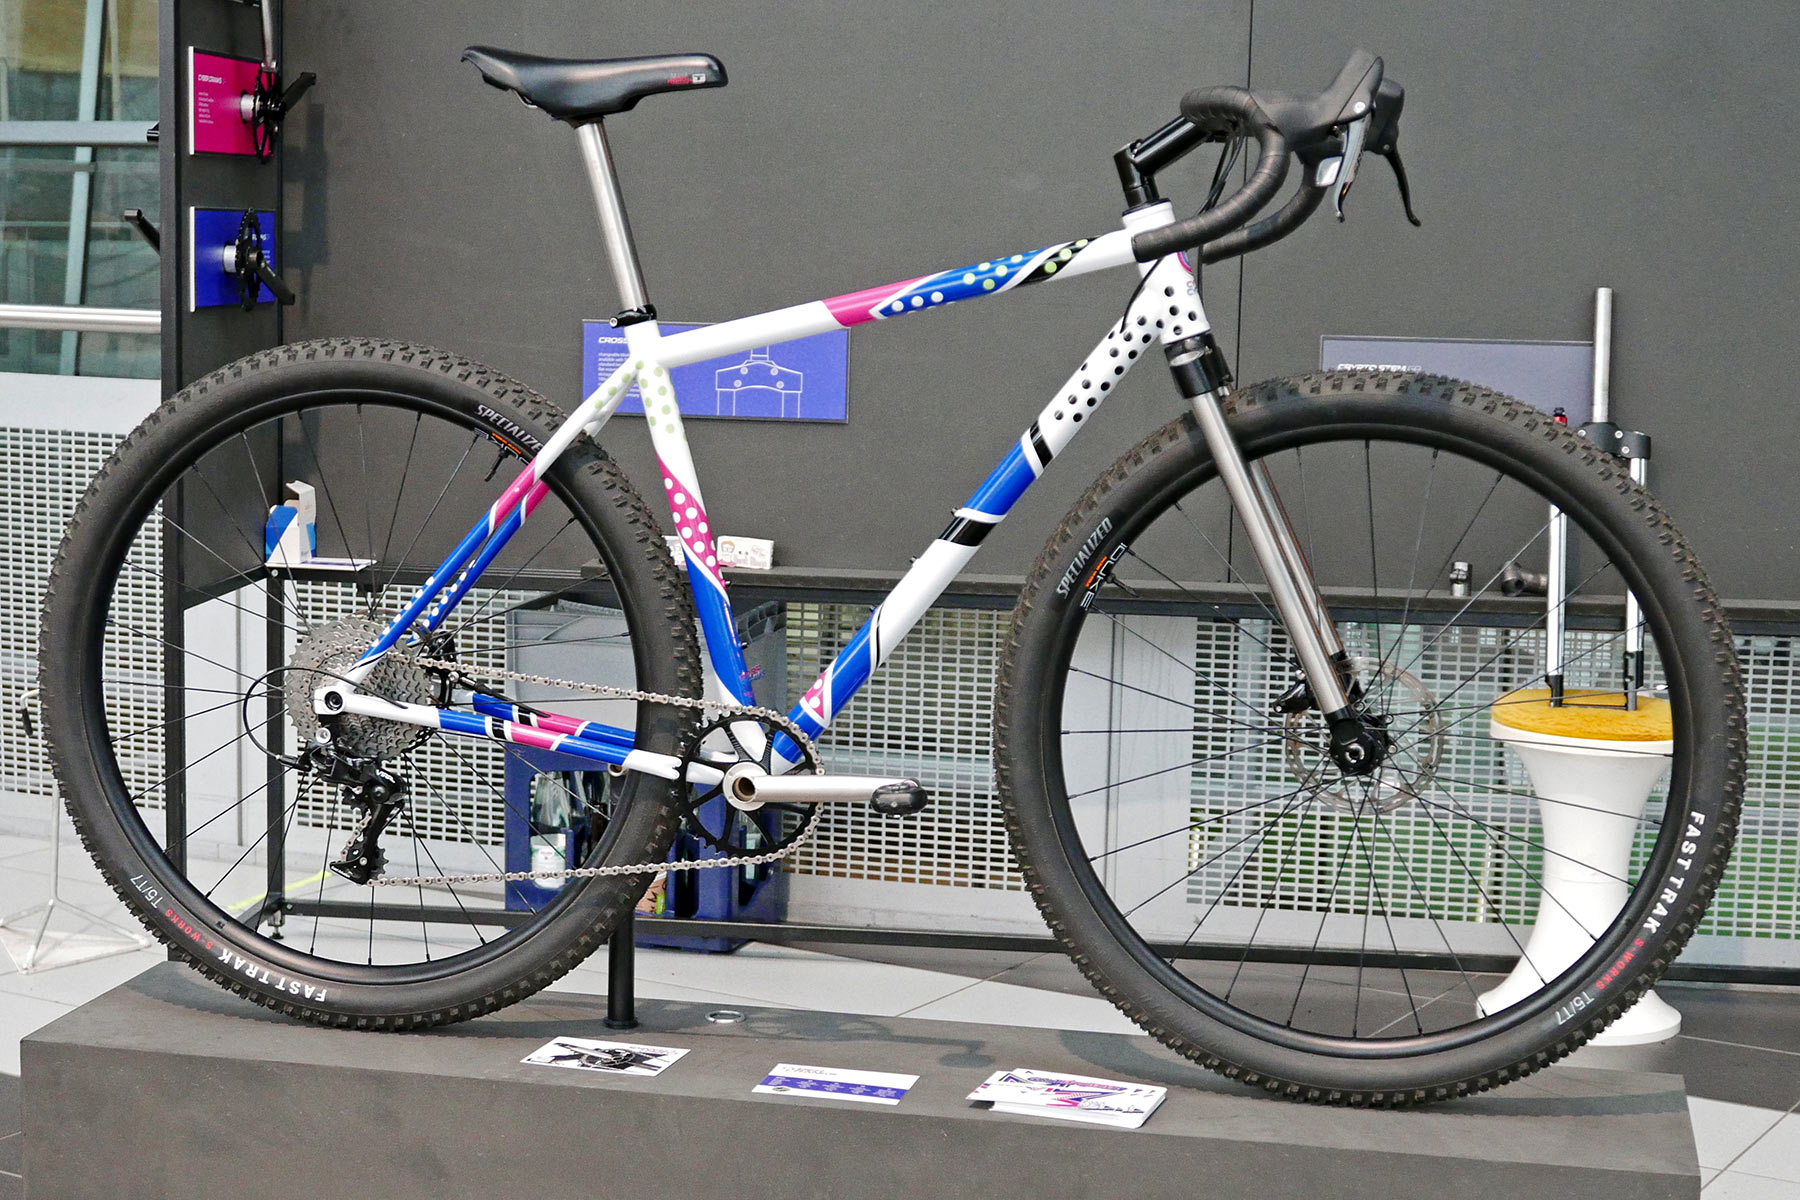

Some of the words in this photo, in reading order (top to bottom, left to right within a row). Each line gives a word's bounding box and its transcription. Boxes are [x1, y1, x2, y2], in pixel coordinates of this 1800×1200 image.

[475, 404, 545, 455] SPECIALIZE
[1056, 517, 1113, 599] SPECIALIZED
[1080, 542, 1128, 611] DUKE
[1677, 811, 1706, 871] FAST
[130, 874, 164, 909] T5/T7
[1643, 876, 1685, 934] TRAK
[164, 908, 213, 950] S-WORKS
[217, 946, 272, 984] TRAK
[1595, 937, 1645, 990] S-WORKS
[275, 980, 328, 1002] FAST
[1554, 991, 1595, 1026] T5/T7
